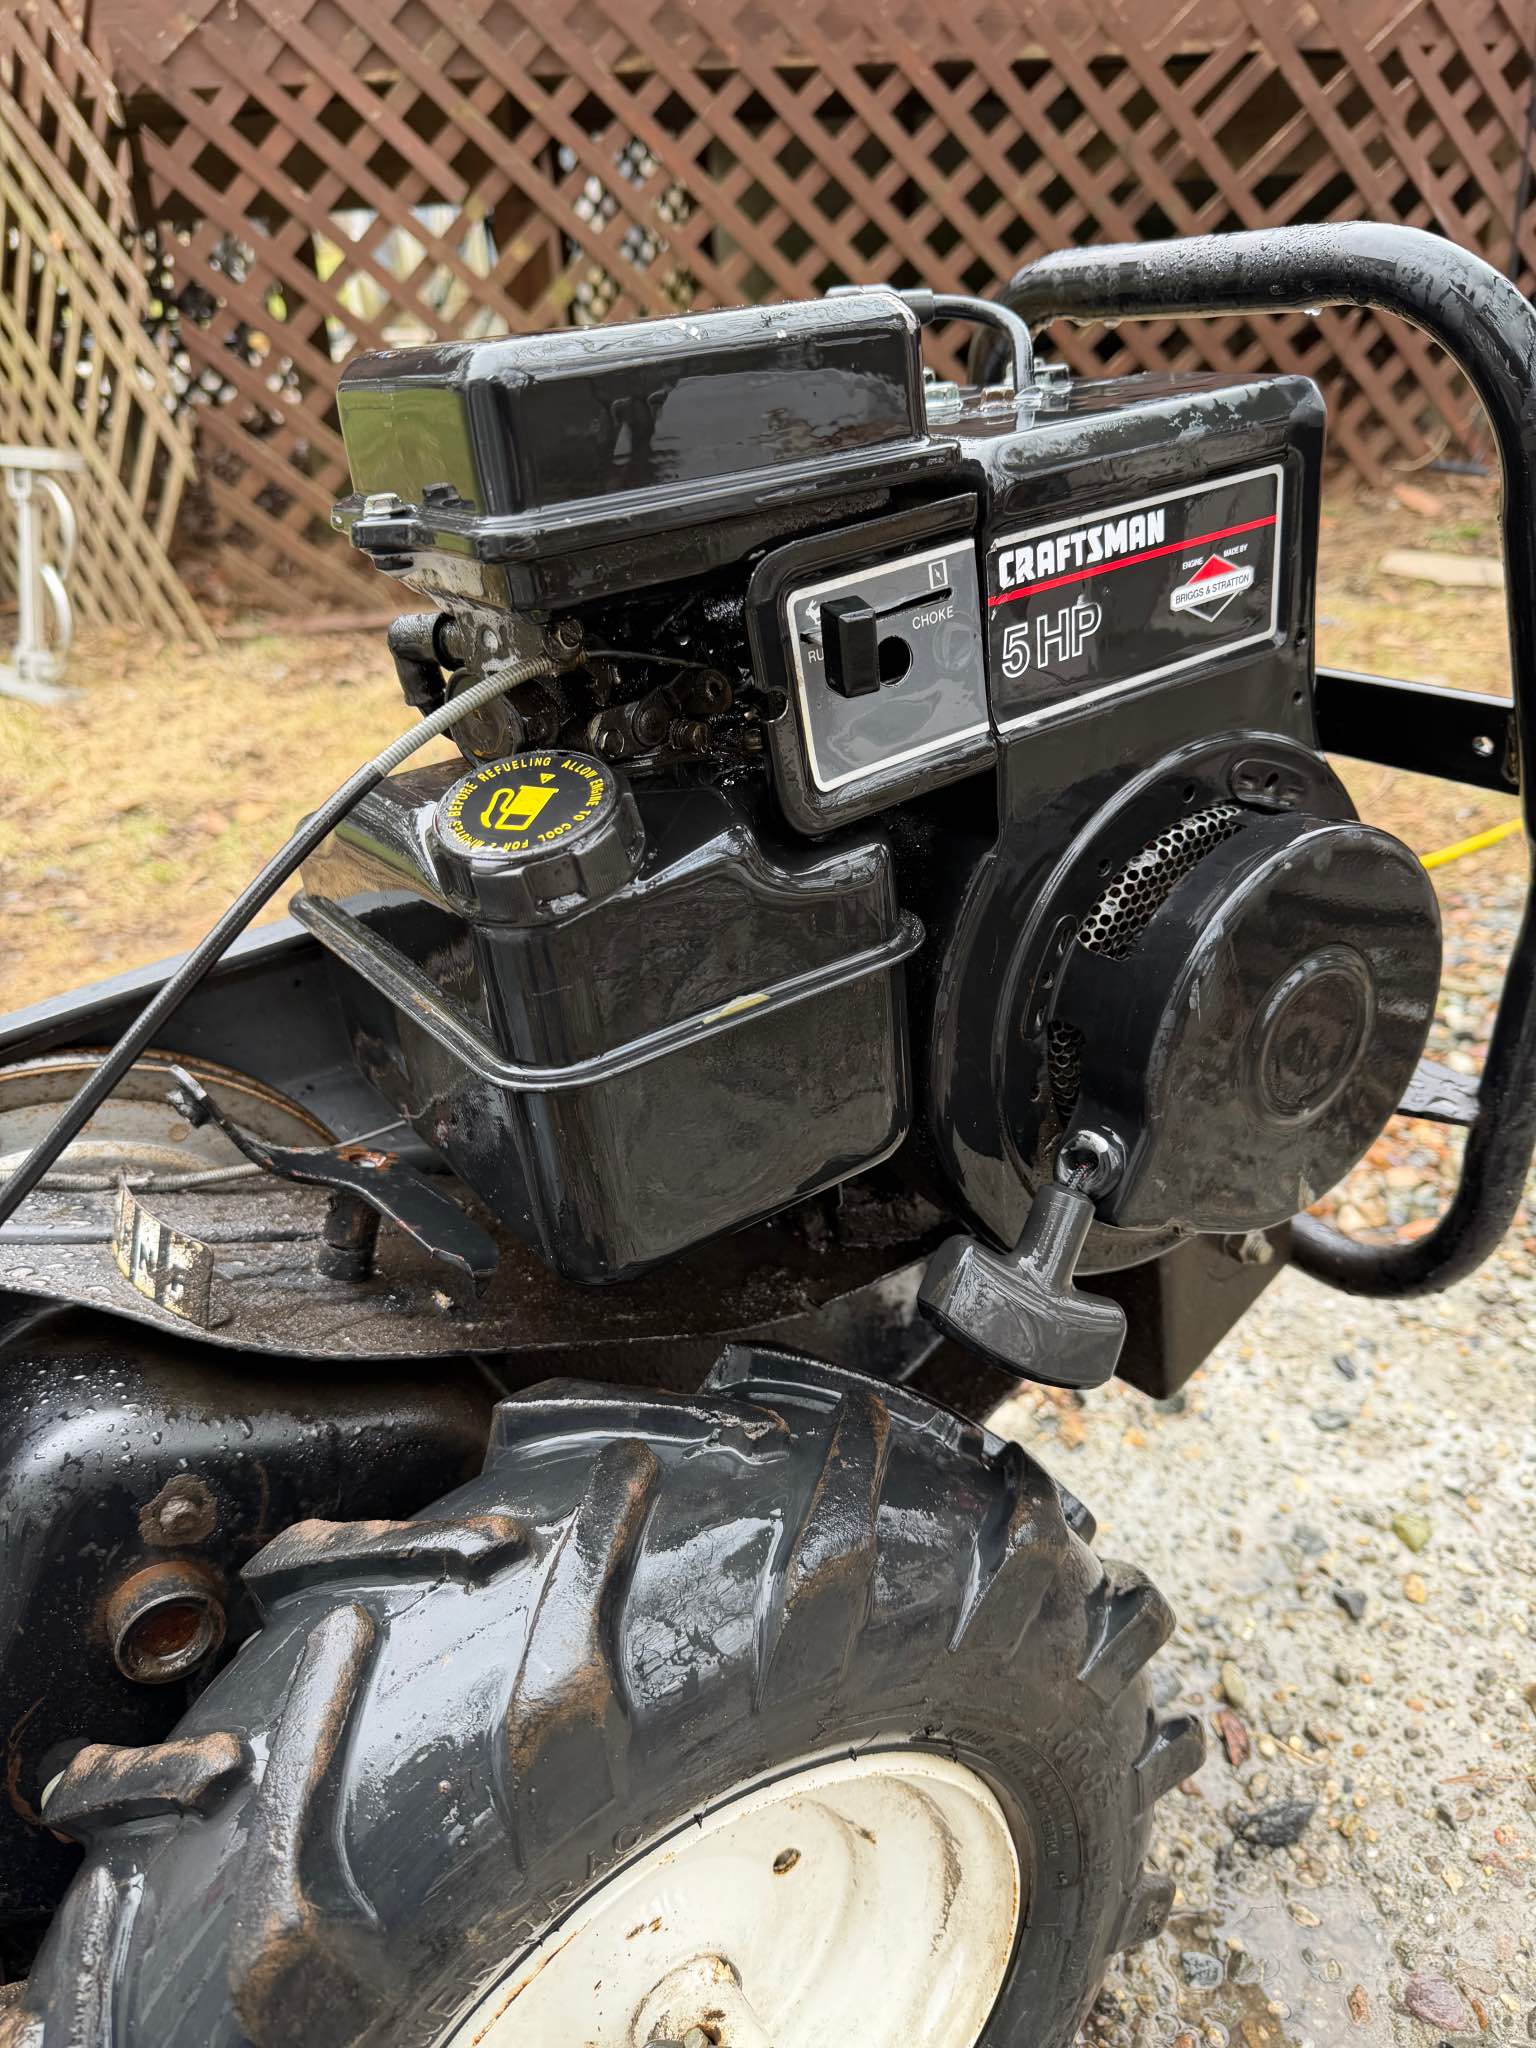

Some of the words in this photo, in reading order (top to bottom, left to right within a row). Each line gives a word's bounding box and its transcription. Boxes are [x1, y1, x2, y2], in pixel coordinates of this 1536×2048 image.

[999, 509, 1165, 590] CRAFTSMAN
[1182, 557, 1204, 570] ENGINE
[1223, 545, 1239, 557] MADE
[1239, 543, 1248, 553] BY
[1175, 587, 1204, 605] BRIGGS
[1205, 585, 1211, 595] &
[1212, 573, 1250, 593] STRATTON
[912, 605, 954, 630] CHOKE
[1002, 622, 1031, 679] 5
[1036, 602, 1102, 669] HP
[807, 647, 824, 663] RU
[477, 757, 552, 782] REFUELING
[561, 759, 598, 779] ALLOW
[447, 782, 478, 818] BEFORE
[585, 778, 604, 807] ENGINE
[573, 810, 592, 821] TO
[450, 820, 485, 849] MINUTES
[537, 823, 572, 842] COOL
[503, 839, 529, 853] FOR
